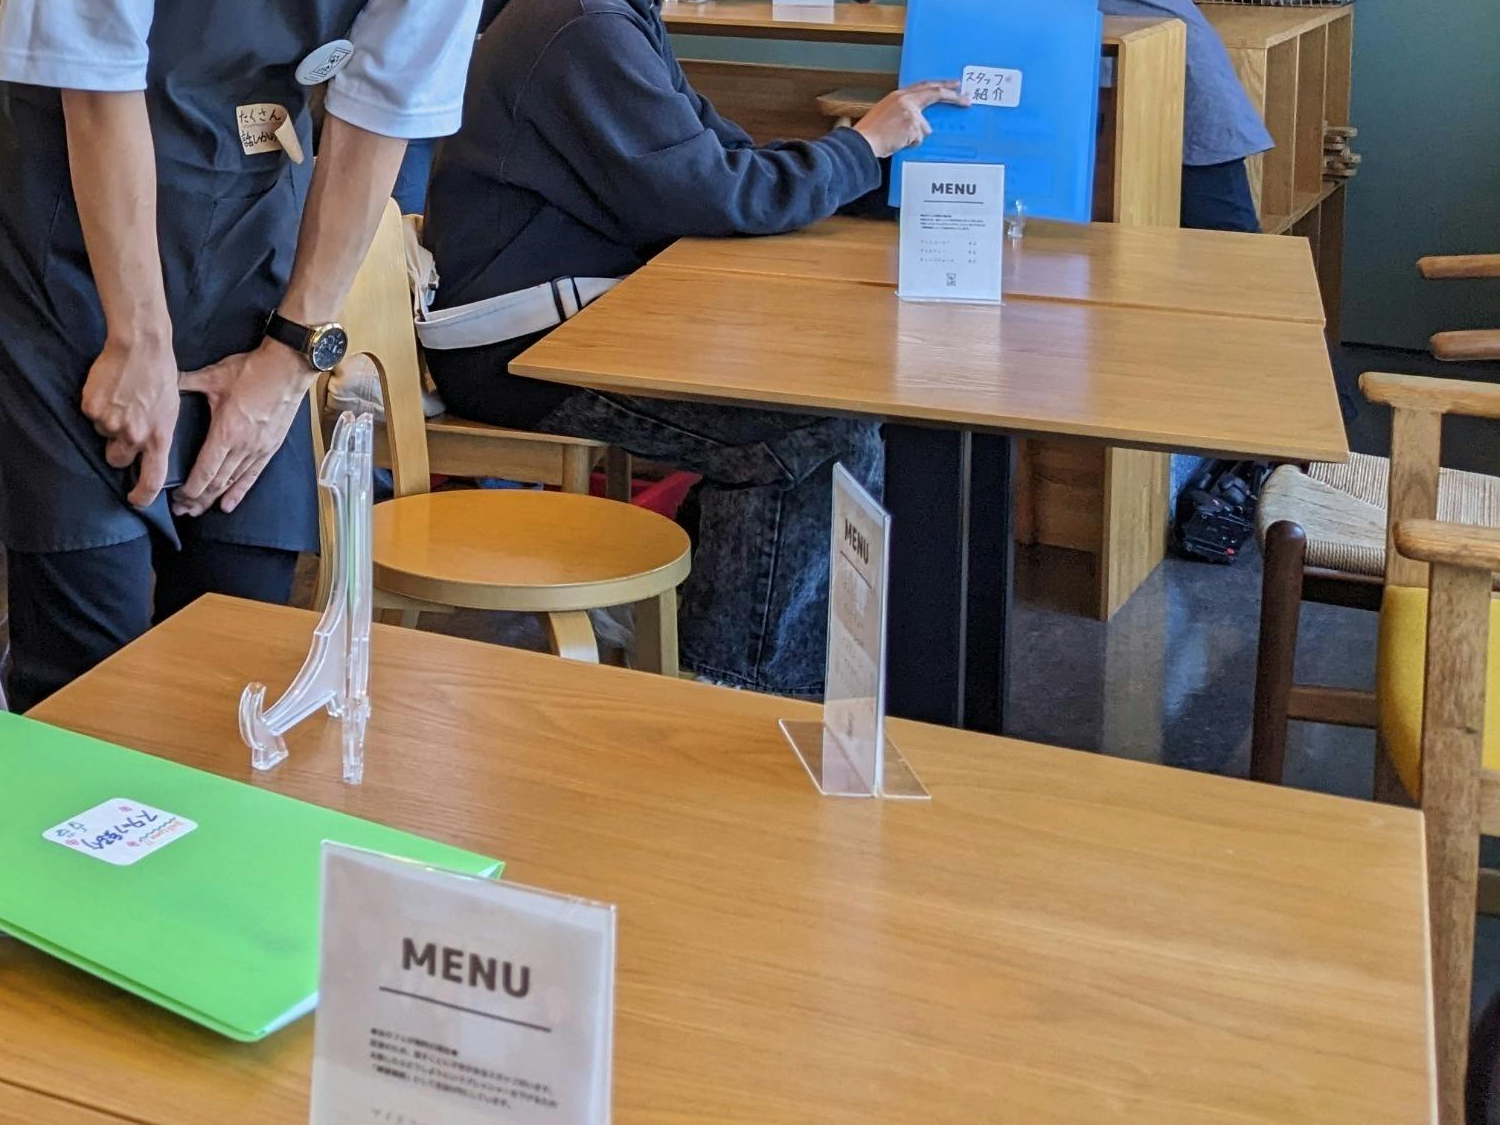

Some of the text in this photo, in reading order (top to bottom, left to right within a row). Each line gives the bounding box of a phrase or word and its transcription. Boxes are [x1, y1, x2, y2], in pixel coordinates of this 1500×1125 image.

[965, 71, 1004, 86] スタッフ
[972, 86, 1004, 102] 紹介
[239, 107, 281, 123] たくさん
[931, 182, 977, 196] MENU
[844, 518, 869, 565] MENU
[401, 936, 531, 999] MENU
